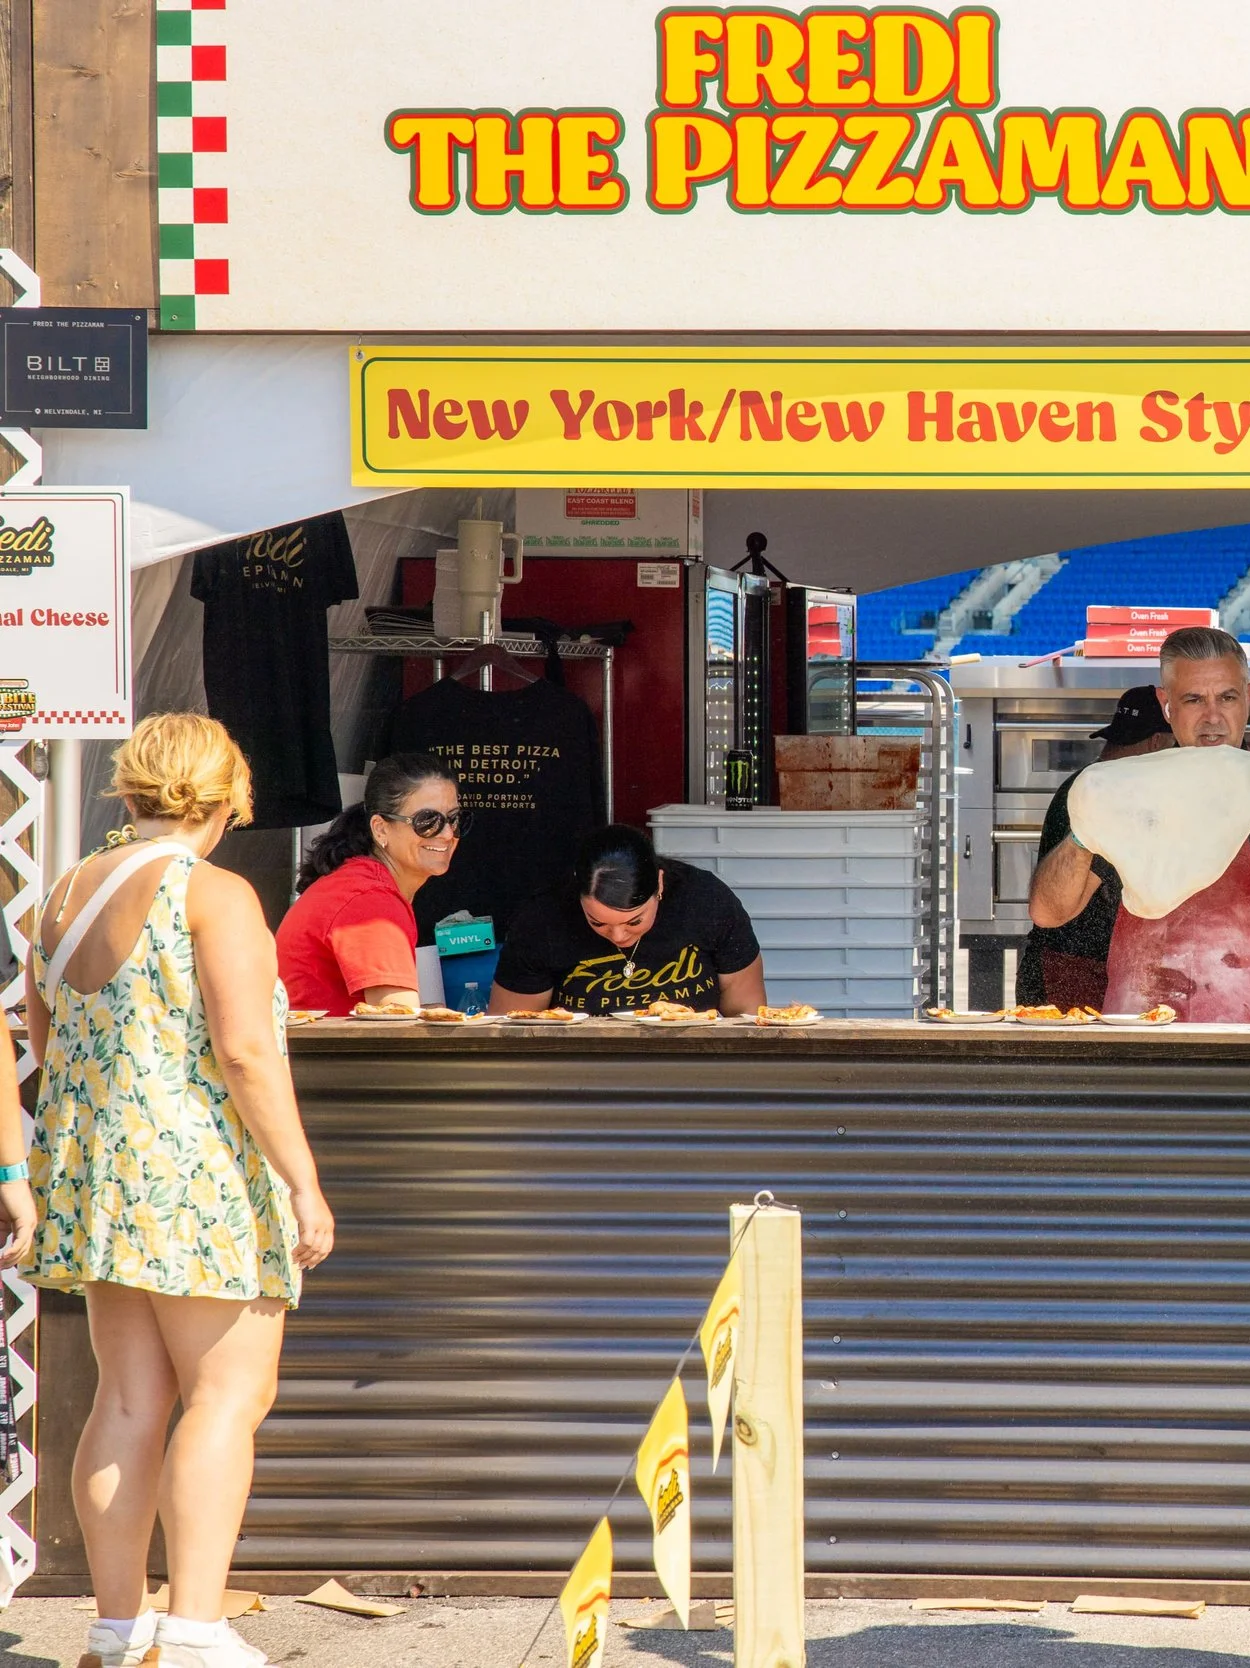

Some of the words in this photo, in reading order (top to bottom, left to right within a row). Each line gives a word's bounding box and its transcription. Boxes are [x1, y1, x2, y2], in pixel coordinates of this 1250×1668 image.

[655, 5, 1000, 113] FREDI
[384, 107, 629, 216] THE
[27, 355, 88, 372] BILT
[44, 408, 90, 416] MELVINDALE,
[387, 388, 529, 442] New
[550, 387, 885, 443] York/New
[906, 390, 1117, 443] Haven
[0, 520, 52, 552] edi
[0, 555, 52, 564] ZZAMAN
[0, 608, 23, 627] al
[31, 608, 110, 627] Cheese
[1131, 612, 1149, 620] Oven
[1150, 612, 1169, 620] Fresh
[1130, 629, 1148, 637] Oven
[1149, 629, 1168, 637] Fresh
[4, 692, 36, 704] BITE
[472, 745, 510, 756] BEST
[517, 745, 561, 758] PIZZA
[448, 760, 463, 769] IN
[470, 759, 541, 772] DETROIT,
[449, 935, 481, 945] VINYL
[563, 943, 703, 994] Fredi
[558, 991, 586, 1009] THE
[601, 976, 715, 1009] PIZZAMAN
